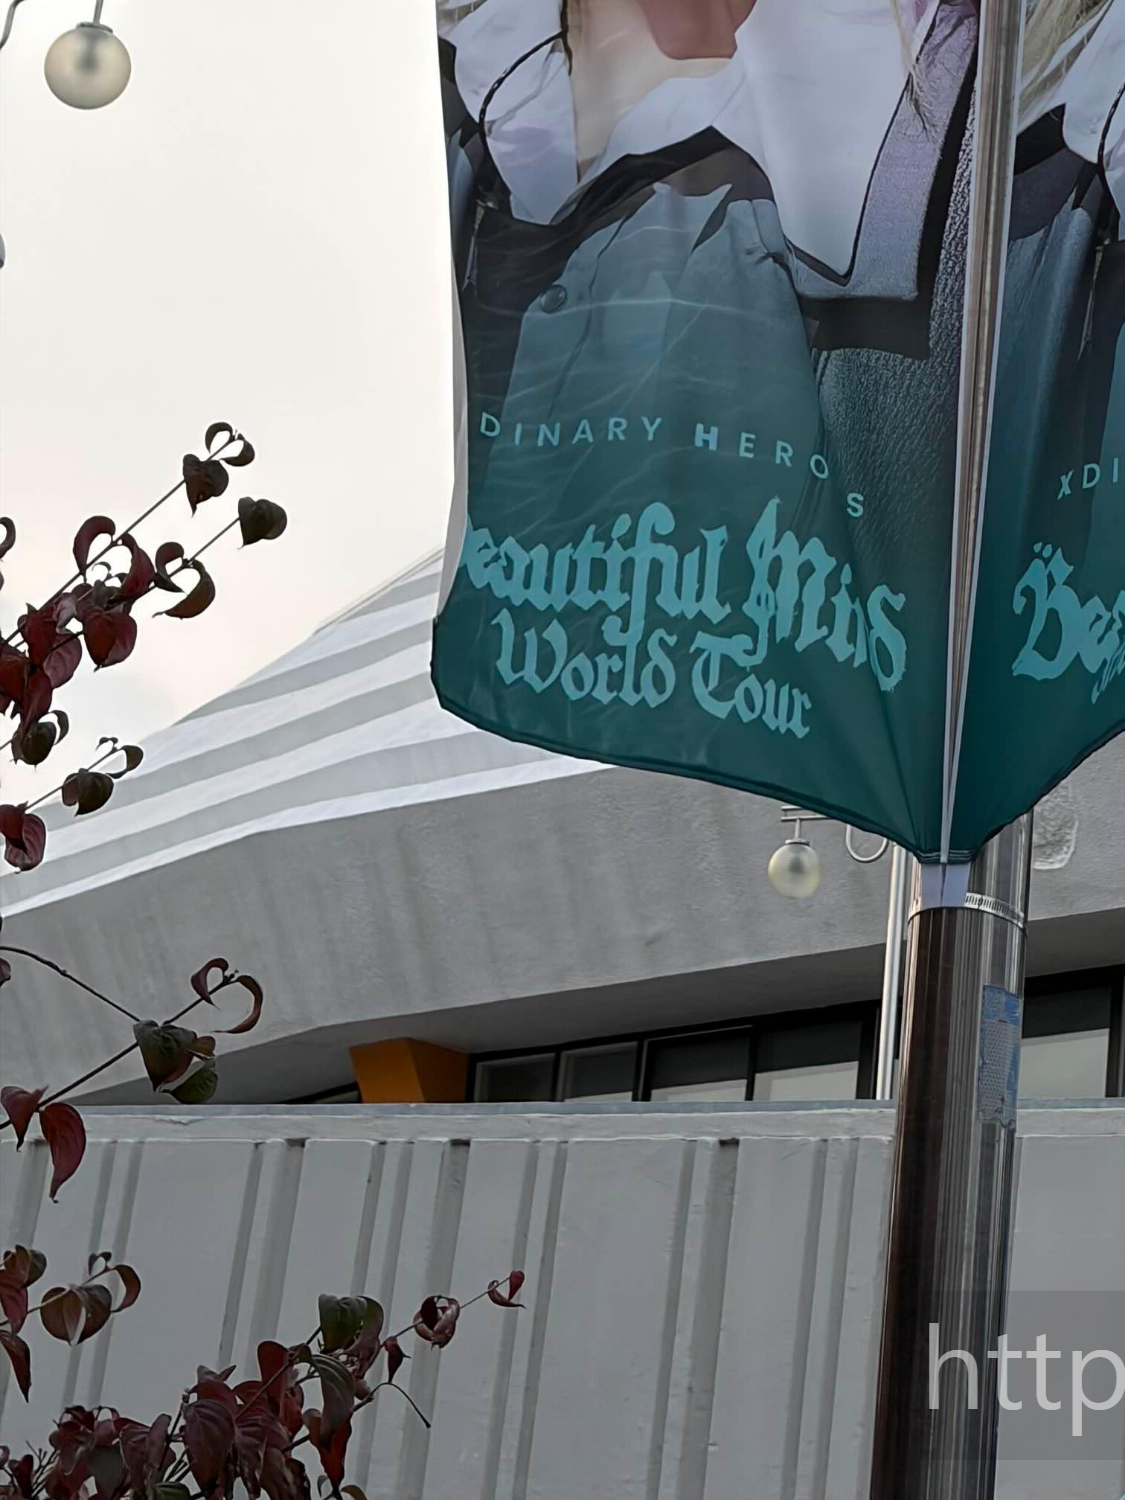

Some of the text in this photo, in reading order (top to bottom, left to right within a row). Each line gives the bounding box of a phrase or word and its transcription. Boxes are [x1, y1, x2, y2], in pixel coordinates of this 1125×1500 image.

[480, 411, 865, 518] DINARY HEROS
[459, 502, 734, 647] eautiful
[491, 608, 812, 739] World Tour
